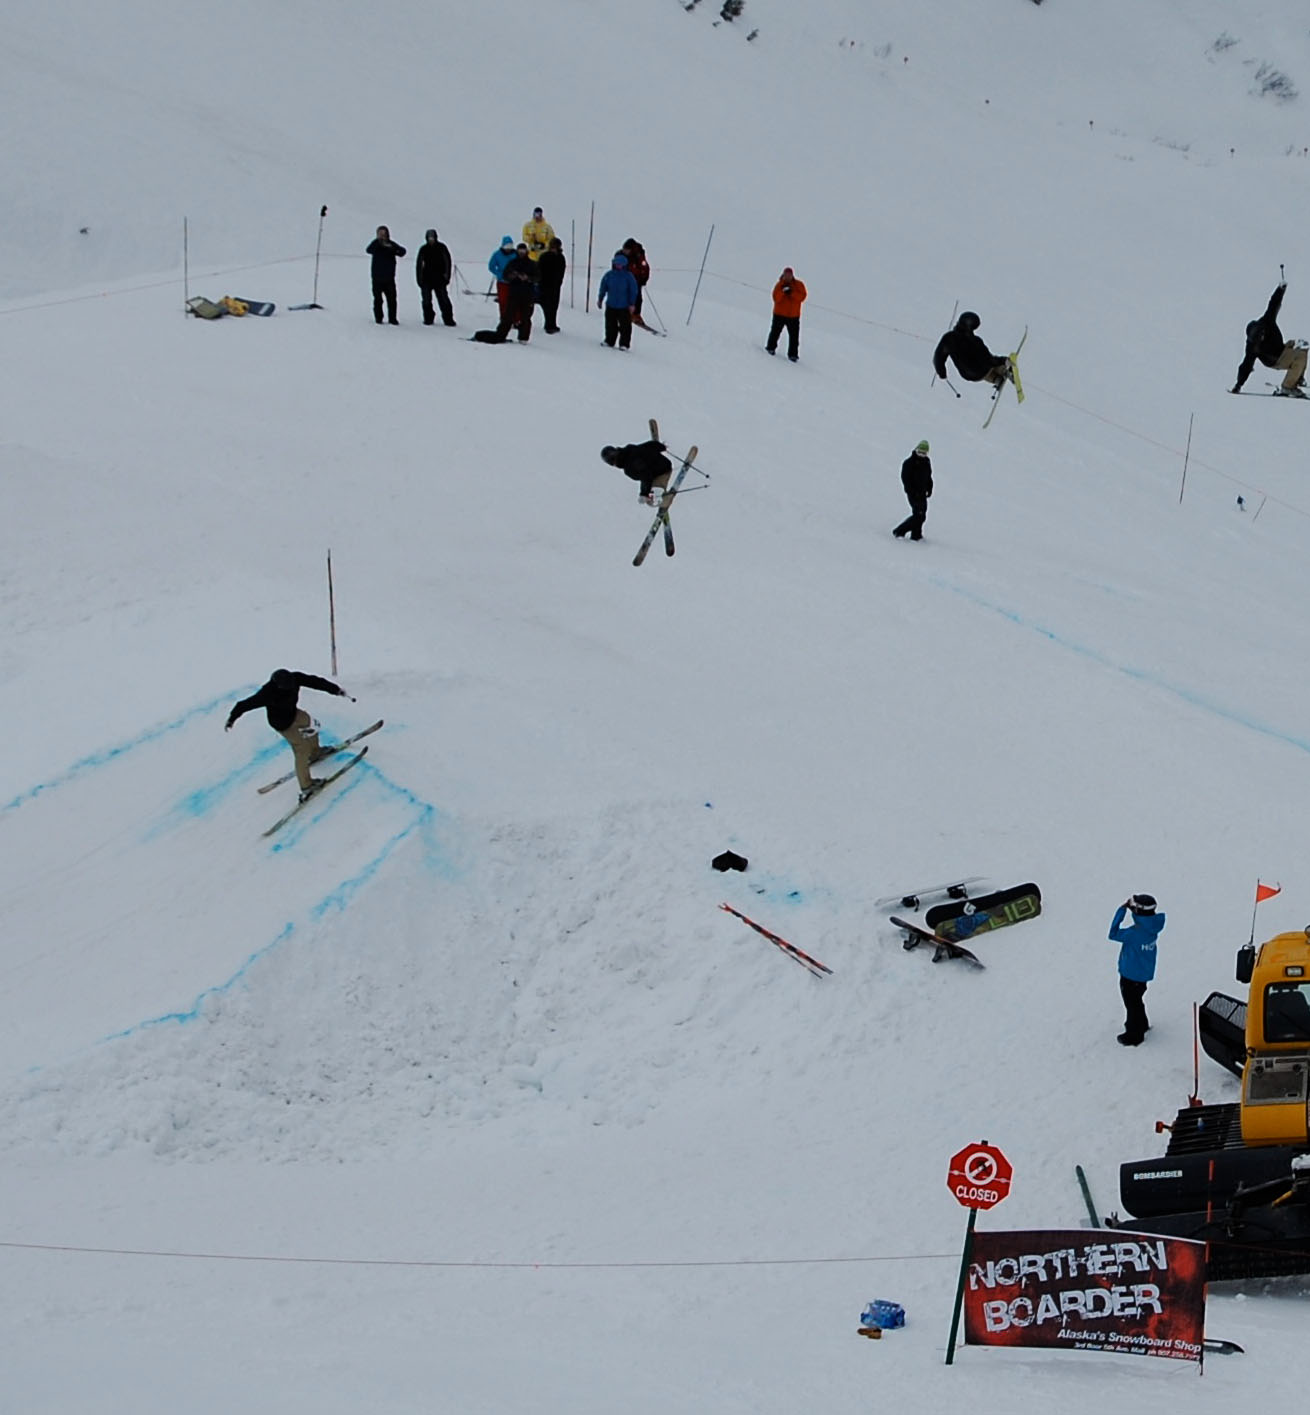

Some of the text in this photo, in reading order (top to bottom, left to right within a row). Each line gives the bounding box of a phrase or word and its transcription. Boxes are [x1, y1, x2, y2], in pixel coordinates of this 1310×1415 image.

[956, 1185, 998, 1202] CLOSED
[969, 1240, 1168, 1290] NORTHERN
[983, 1283, 1163, 1333] BOARDER
[1057, 1328, 1202, 1354] Alaska's Snowboard Shop
